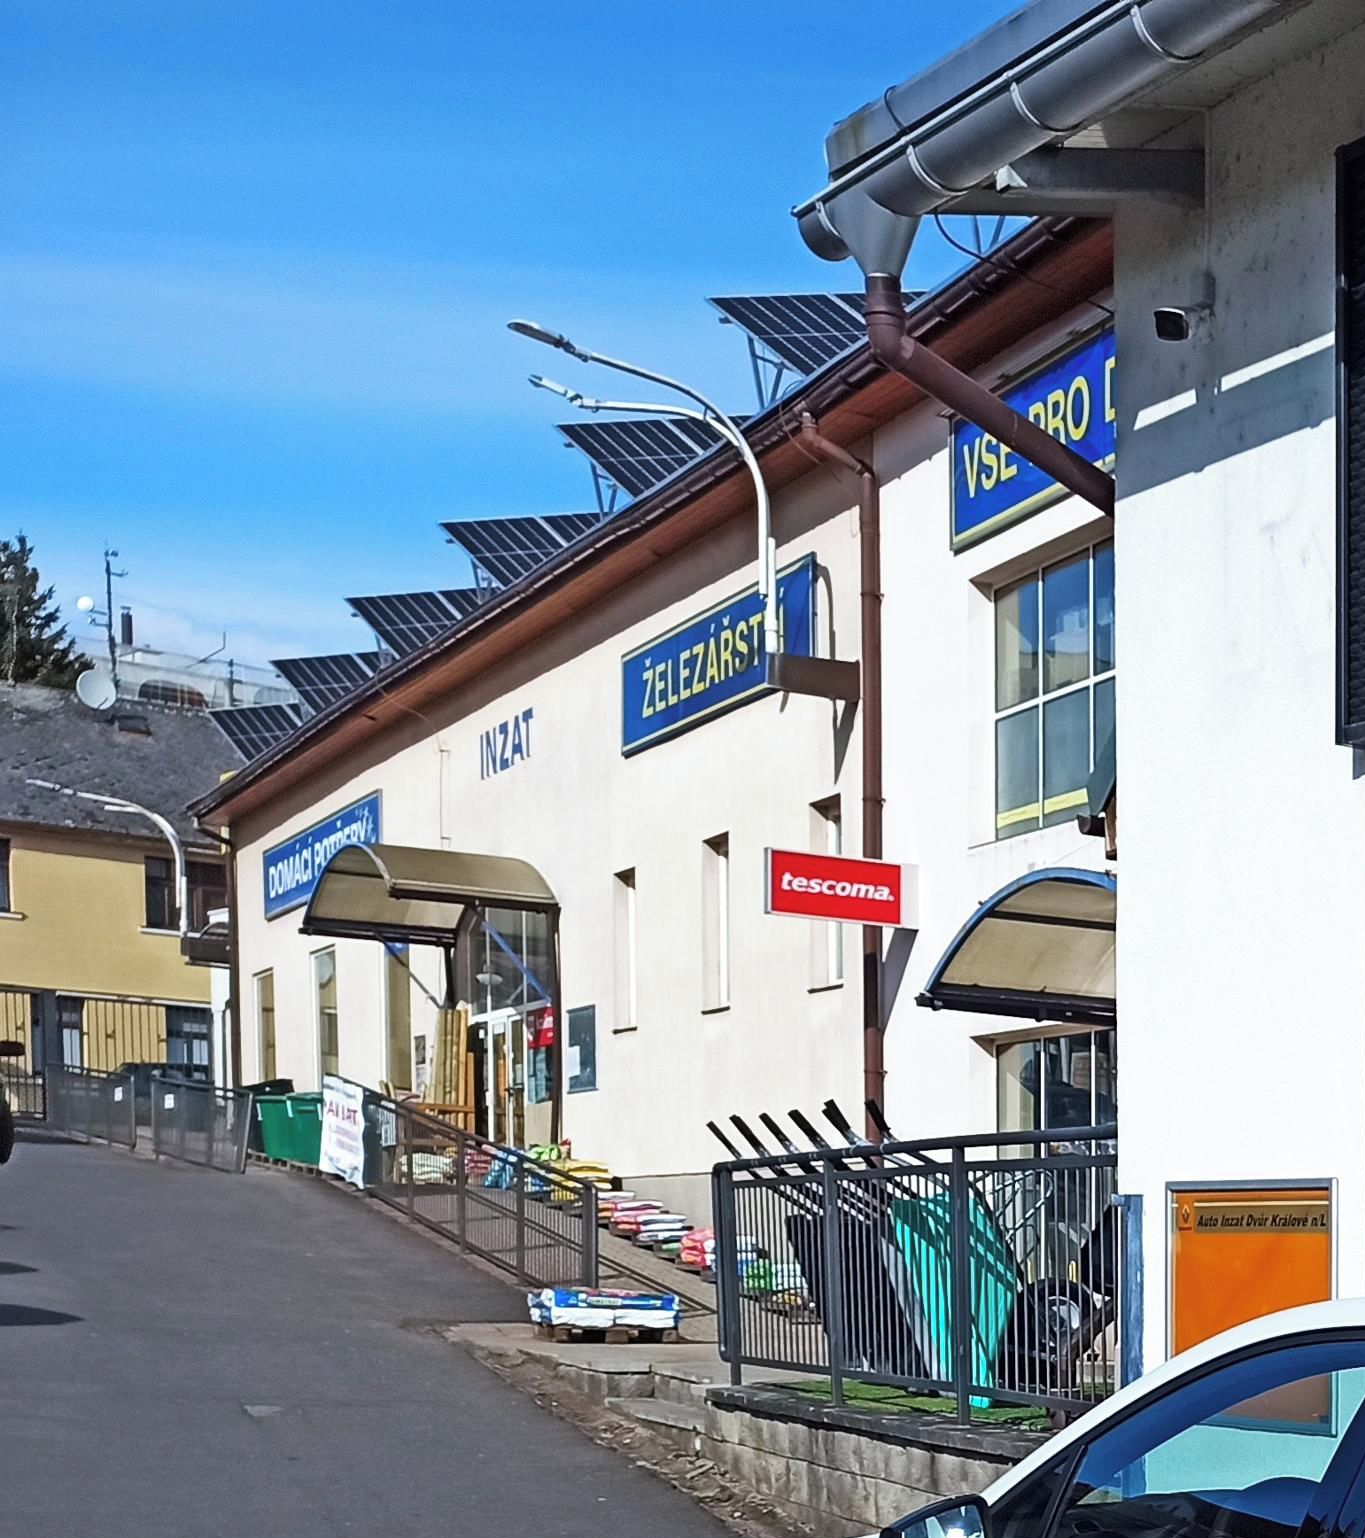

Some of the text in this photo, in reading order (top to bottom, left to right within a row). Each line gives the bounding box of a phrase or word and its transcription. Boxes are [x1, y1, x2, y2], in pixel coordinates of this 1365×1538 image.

[642, 586, 785, 719] ŽELEZÁŘSTÍ
[480, 707, 533, 780] INZAT
[268, 836, 312, 899] DOMÁCÍ
[1197, 1214, 1218, 1227] Auto
[1220, 1213, 1244, 1227] Inzat
